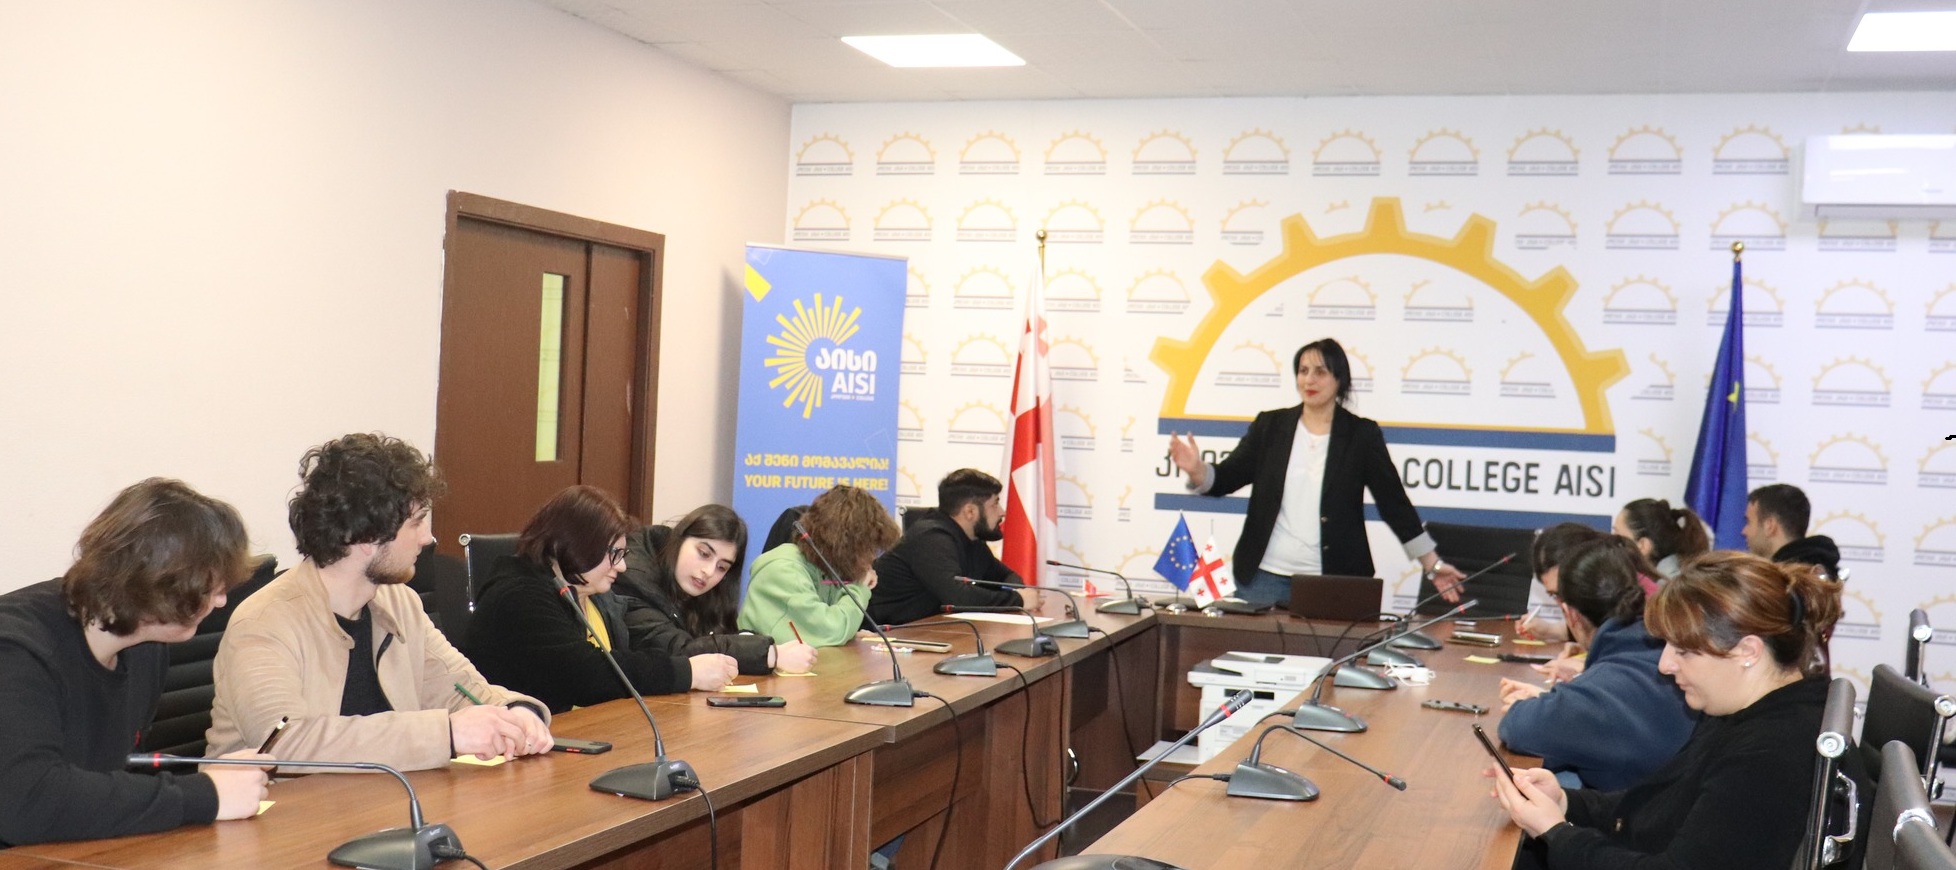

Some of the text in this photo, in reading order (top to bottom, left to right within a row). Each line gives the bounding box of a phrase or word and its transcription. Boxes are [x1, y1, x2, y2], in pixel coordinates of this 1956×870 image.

[814, 347, 878, 372] აისი
[831, 372, 876, 395] AISI
[745, 453, 889, 470] აქ შენი მომავალია!
[744, 474, 781, 488] YOUR
[784, 475, 834, 489] FUTURE
[853, 477, 889, 490] HERE!
[1403, 457, 1616, 498] COLLEGE AISI
